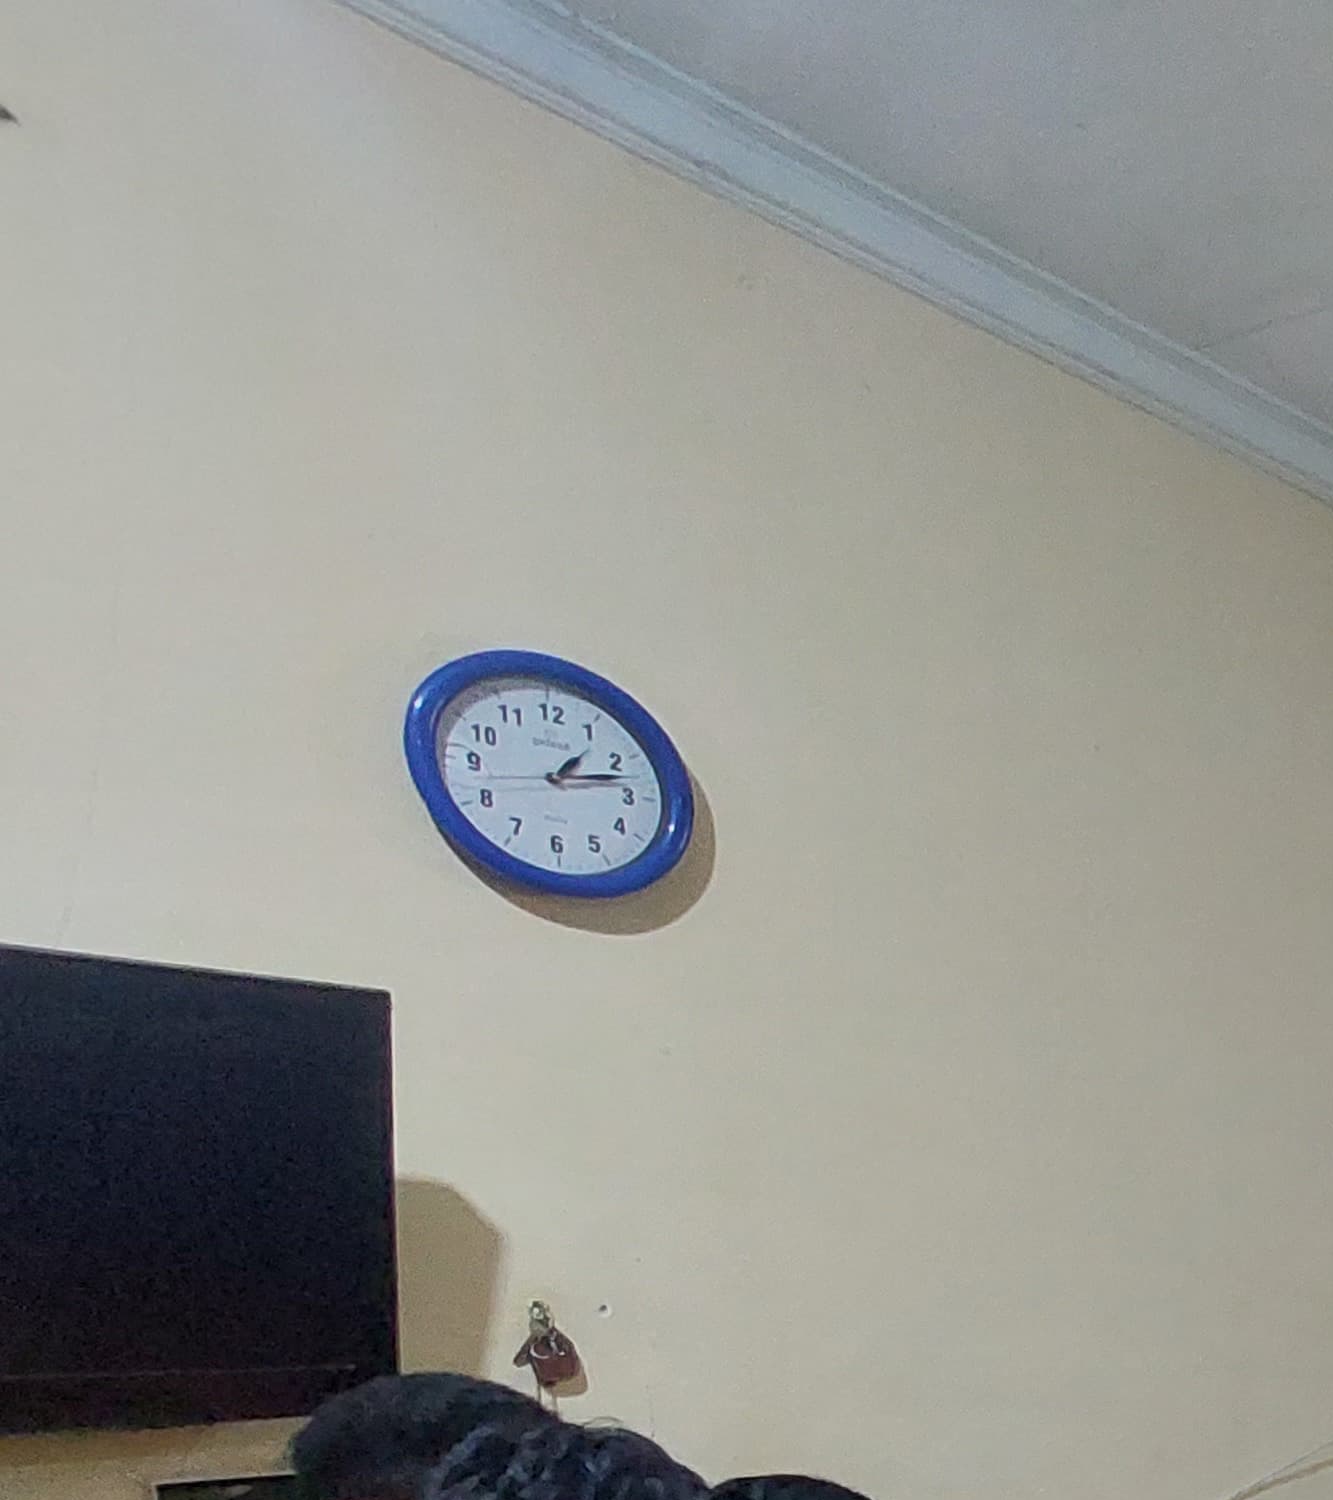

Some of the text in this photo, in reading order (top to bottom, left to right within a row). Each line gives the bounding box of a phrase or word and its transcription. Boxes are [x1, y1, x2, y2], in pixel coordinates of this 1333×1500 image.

[498, 704, 522, 726] 11
[538, 703, 566, 725] 12
[471, 724, 497, 746] 10
[583, 724, 593, 741] 1
[467, 751, 481, 771] 9
[609, 752, 622, 771] 2
[480, 789, 494, 808] 8
[622, 788, 635, 806] 3
[508, 817, 523, 835] 7
[613, 817, 626, 835] 4
[550, 835, 564, 853] 6
[588, 835, 601, 853] 5
